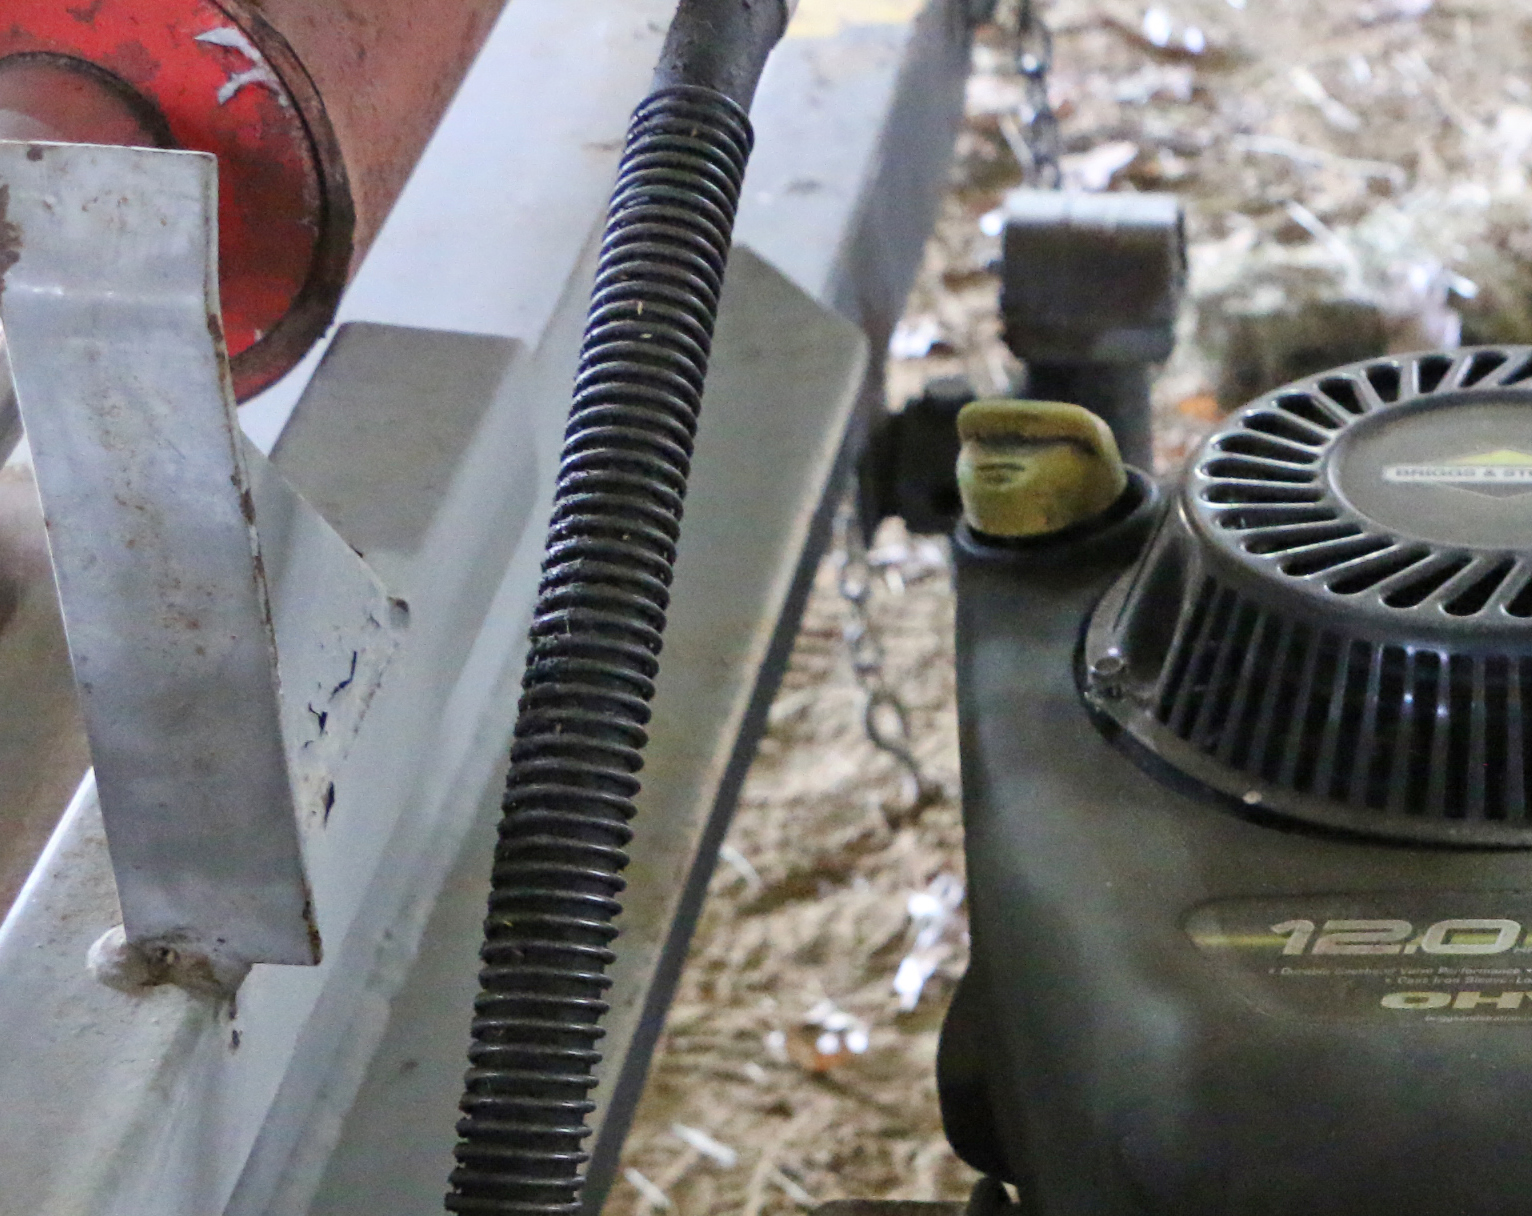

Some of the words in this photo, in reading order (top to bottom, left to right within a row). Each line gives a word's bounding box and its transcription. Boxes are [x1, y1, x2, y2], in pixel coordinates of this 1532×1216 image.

[1394, 467, 1477, 478] BRIGGS
[1482, 468, 1498, 478] &
[1270, 919, 1521, 954] 12.0
